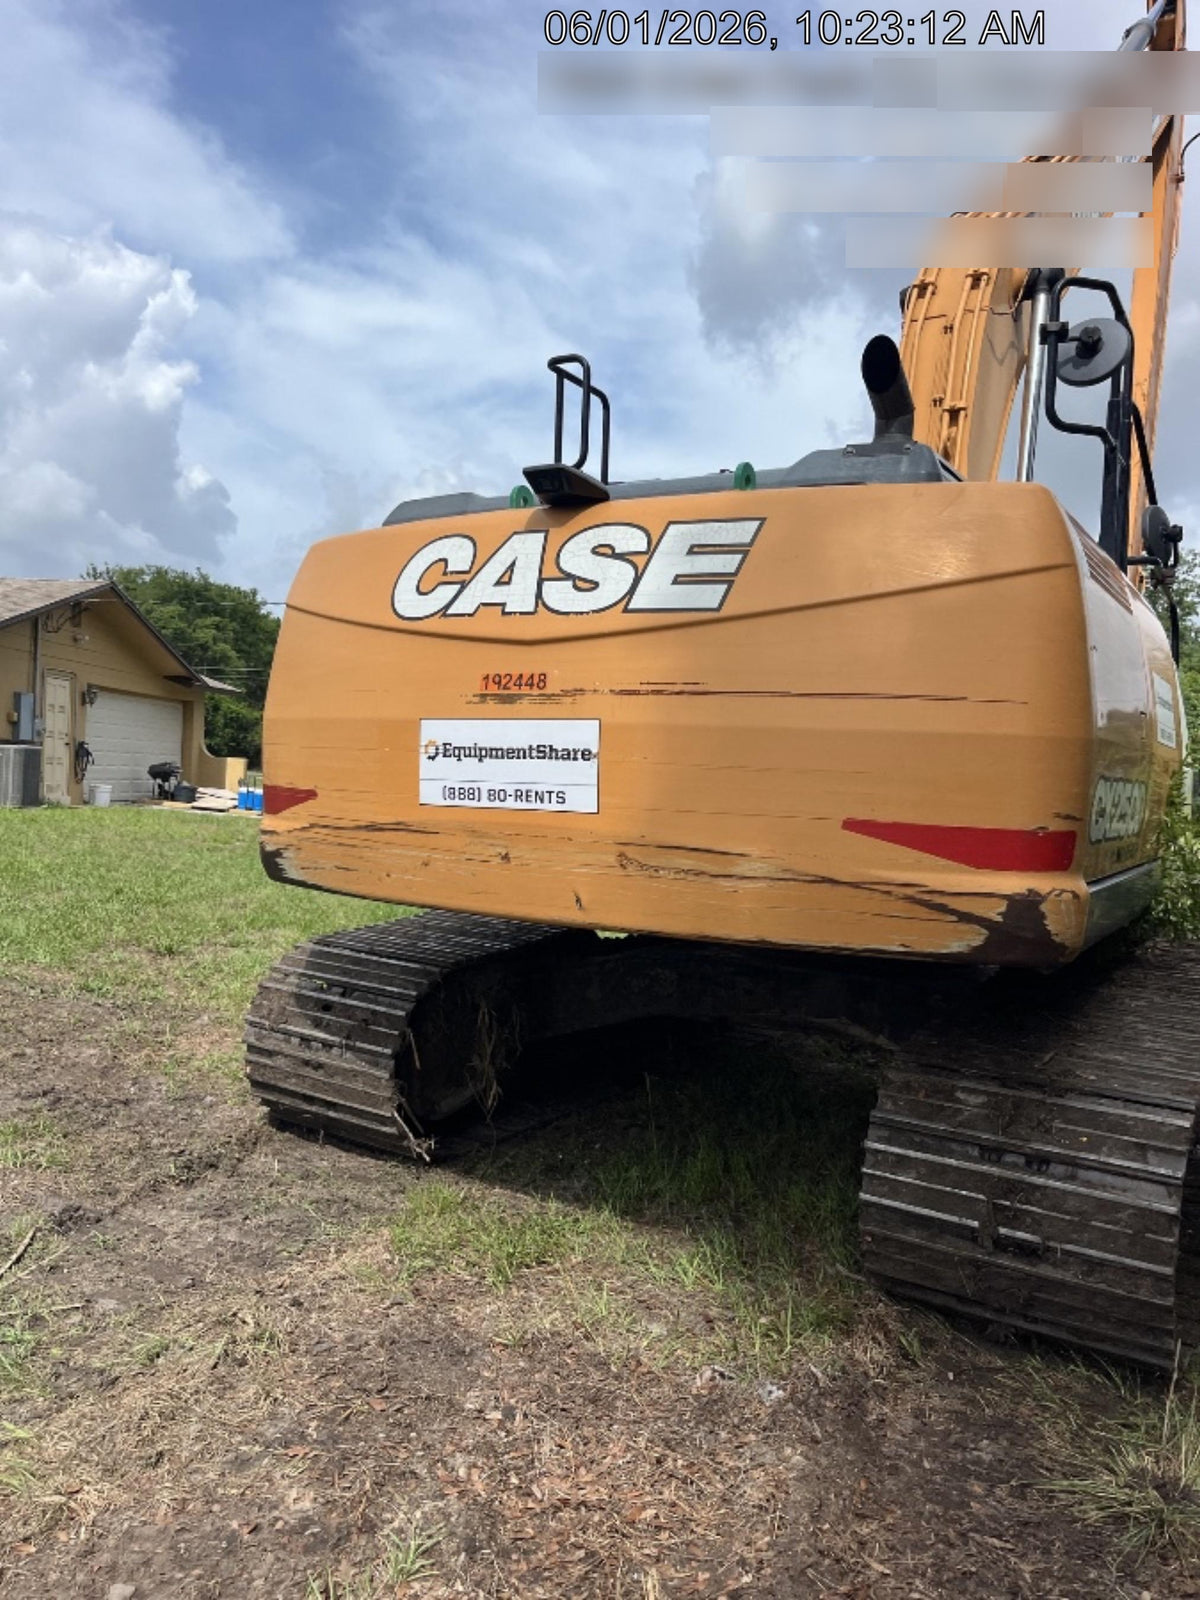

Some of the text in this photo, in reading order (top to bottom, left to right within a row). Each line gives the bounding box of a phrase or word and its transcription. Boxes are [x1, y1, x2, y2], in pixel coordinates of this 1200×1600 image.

[391, 517, 767, 620] CASE
[481, 672, 548, 691] 192448
[442, 742, 593, 762] EquipmentShare
[441, 785, 567, 805] (888) 80-RENTS
